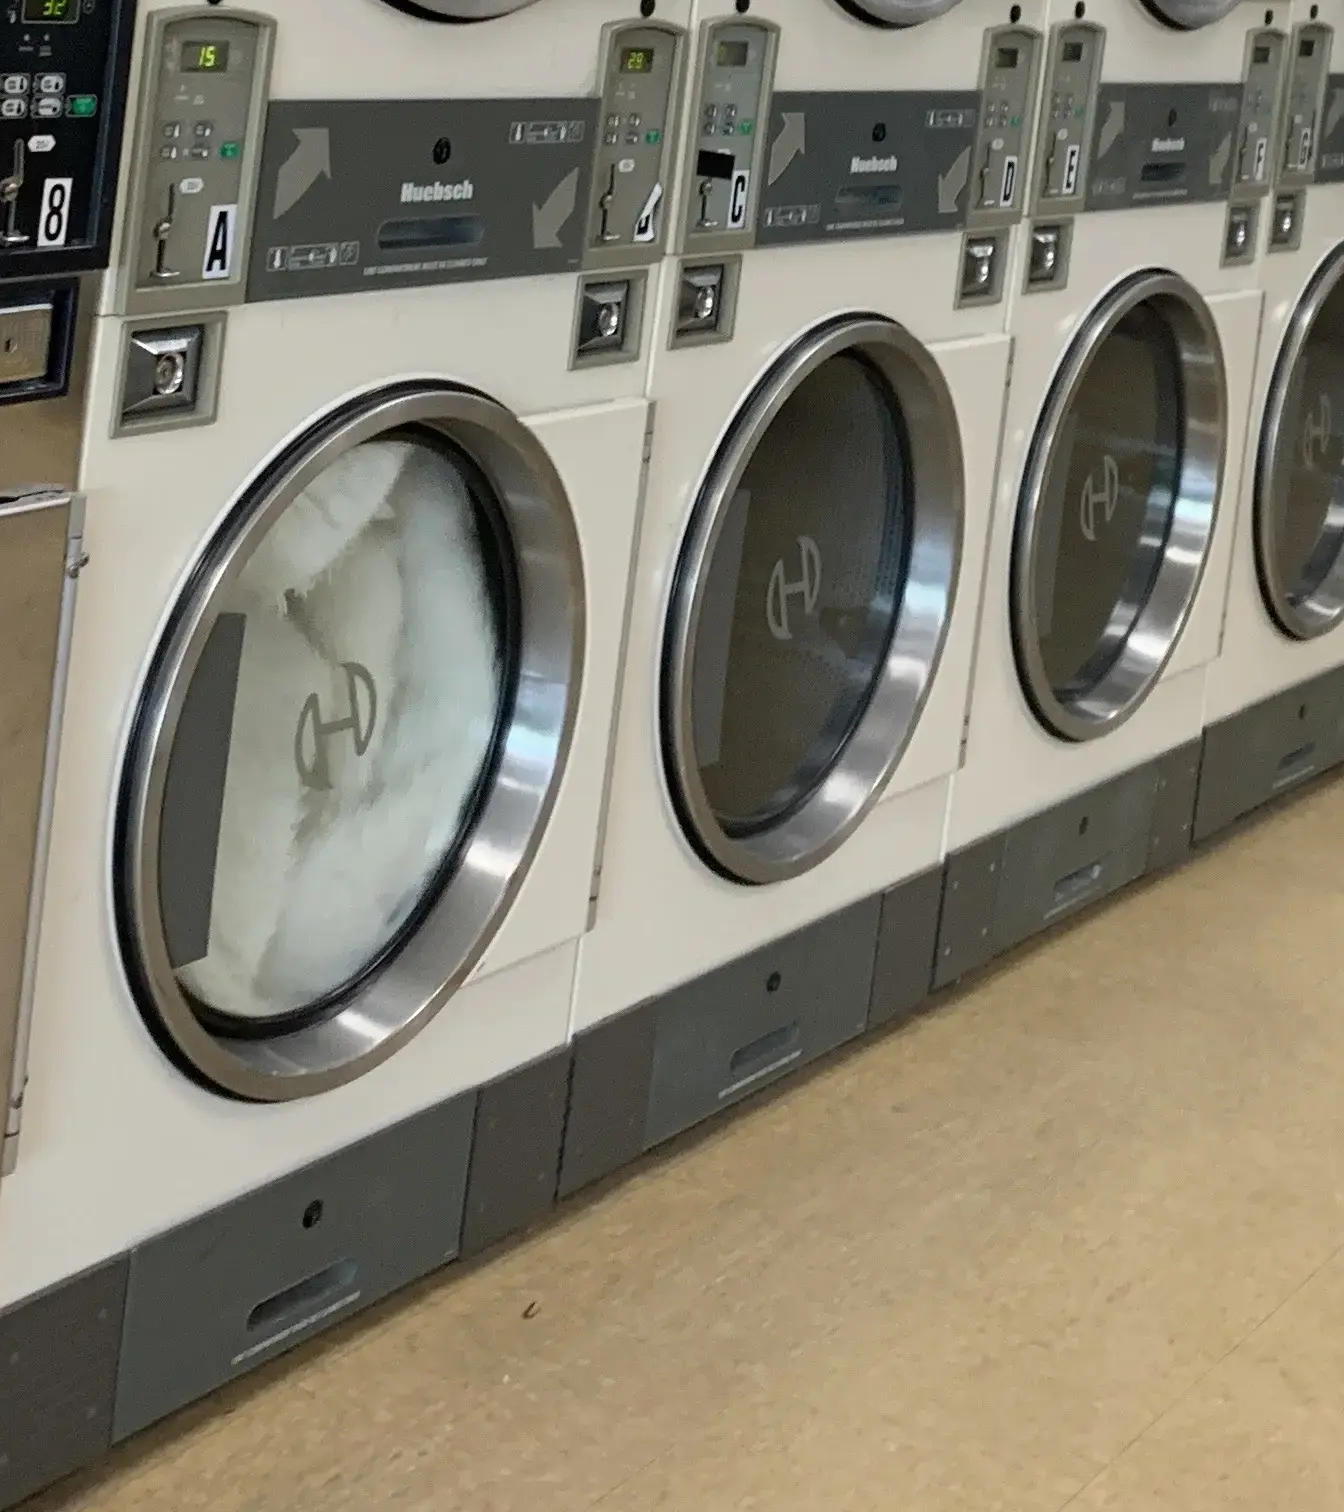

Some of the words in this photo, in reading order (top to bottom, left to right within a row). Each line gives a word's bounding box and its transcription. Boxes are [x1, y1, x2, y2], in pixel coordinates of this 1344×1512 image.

[198, 46, 216, 67] 15
[400, 179, 473, 203] Huebsch
[731, 175, 746, 224] C
[1003, 160, 1015, 202] D
[44, 183, 66, 242] 8
[205, 210, 228, 272] A
